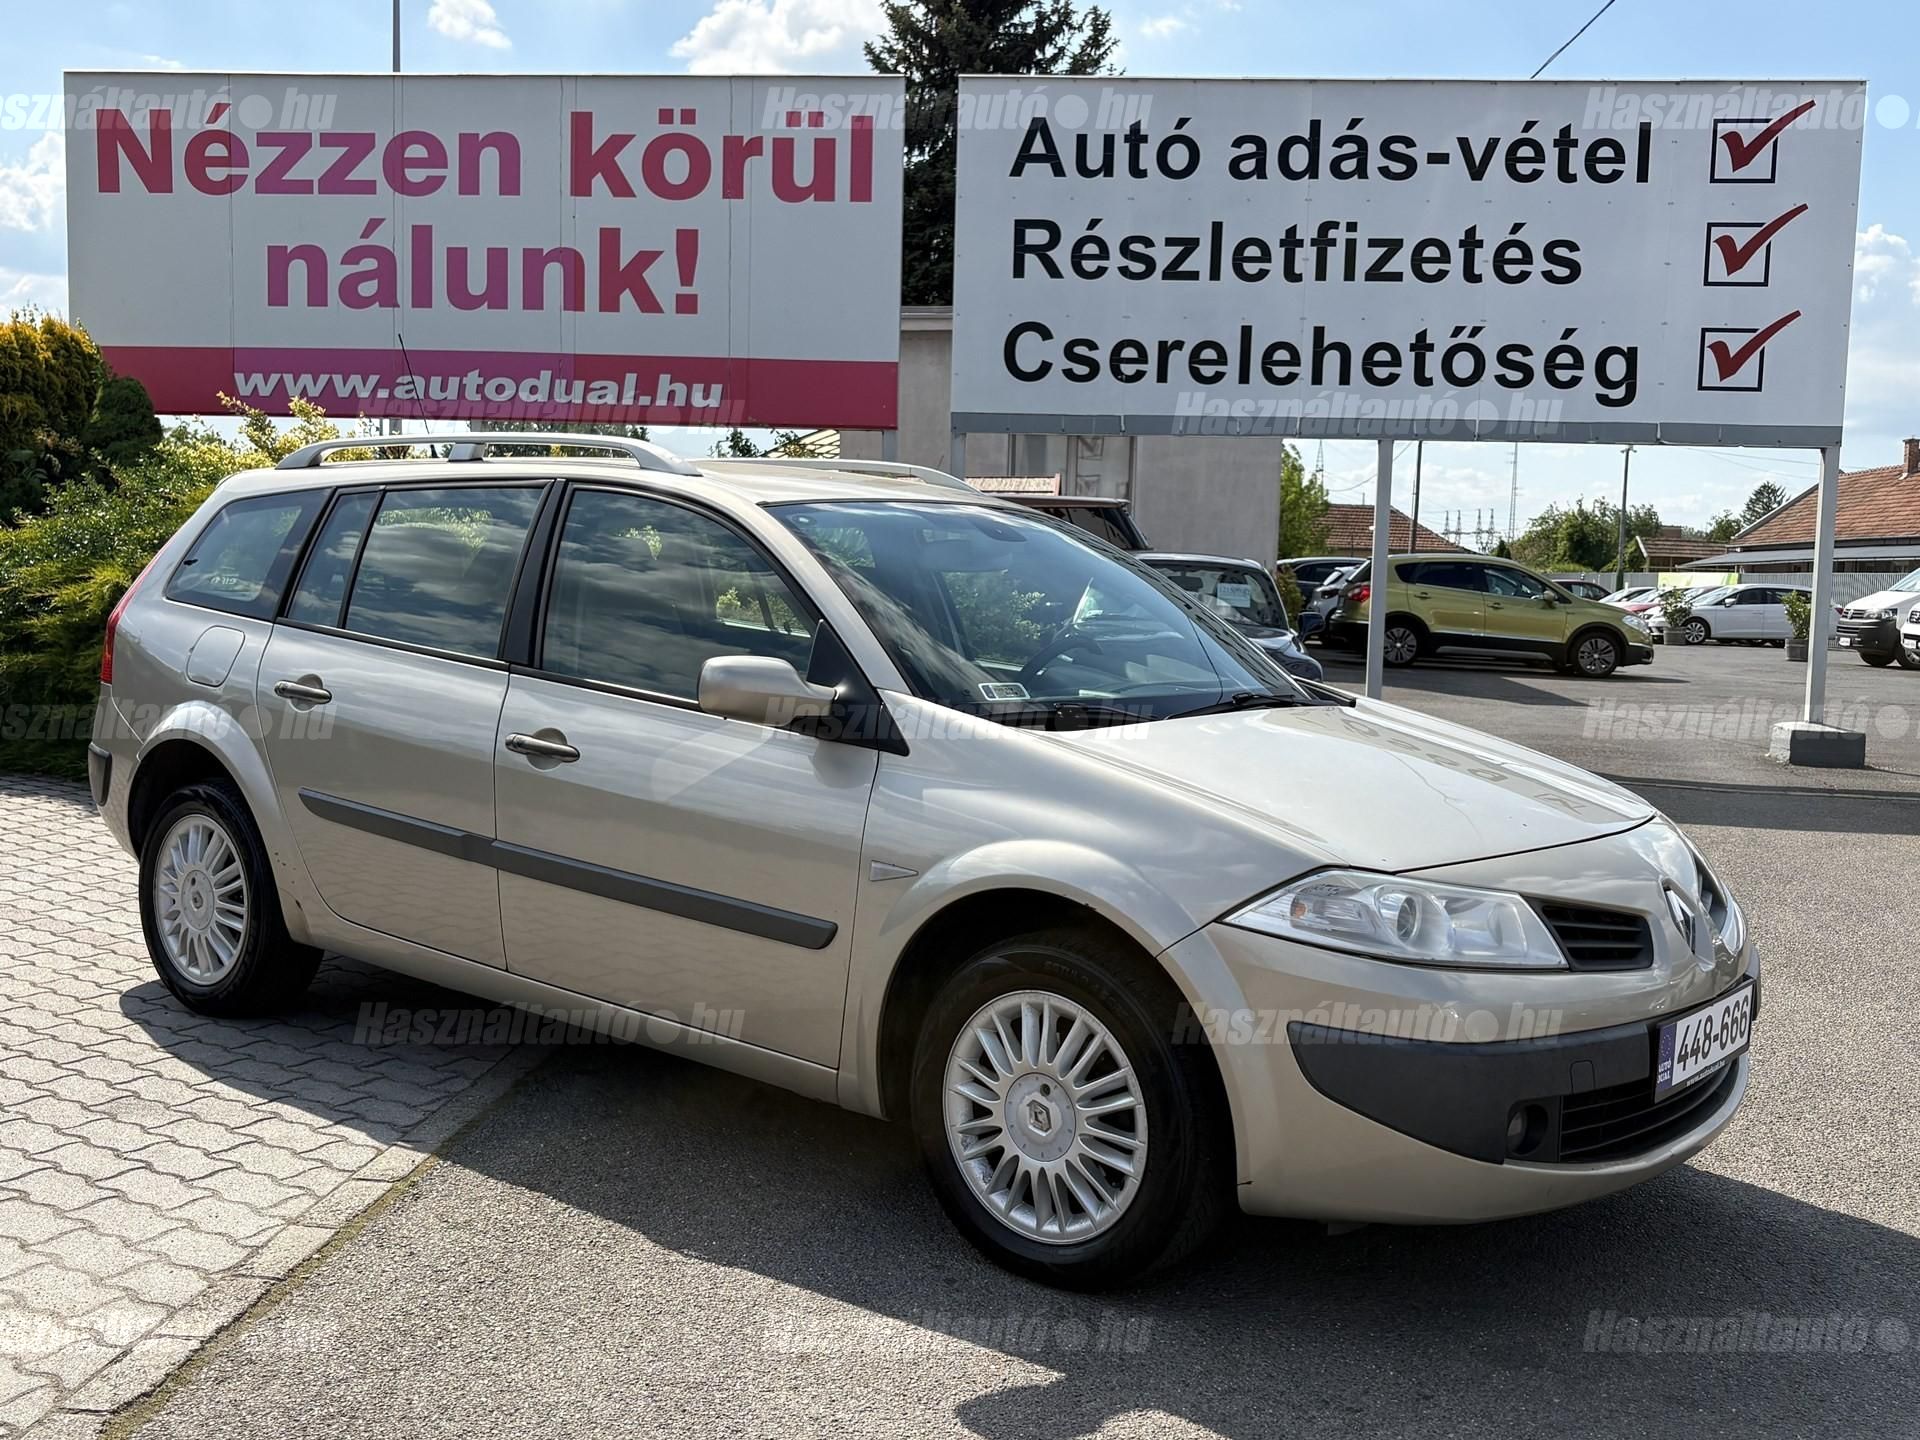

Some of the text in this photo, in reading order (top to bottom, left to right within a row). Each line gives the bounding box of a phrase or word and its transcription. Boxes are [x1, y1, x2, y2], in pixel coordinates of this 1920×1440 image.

[98, 104, 873, 202] Nézzen körül
[1009, 117, 1651, 184] Autó adás-vétel
[267, 218, 699, 315] nálunk!
[1012, 218, 1582, 285] Részletfizetés
[233, 370, 723, 408] www.autodual.hu
[1004, 321, 1638, 408] Cserelehetőség
[1677, 994, 1749, 1071] 448-666
